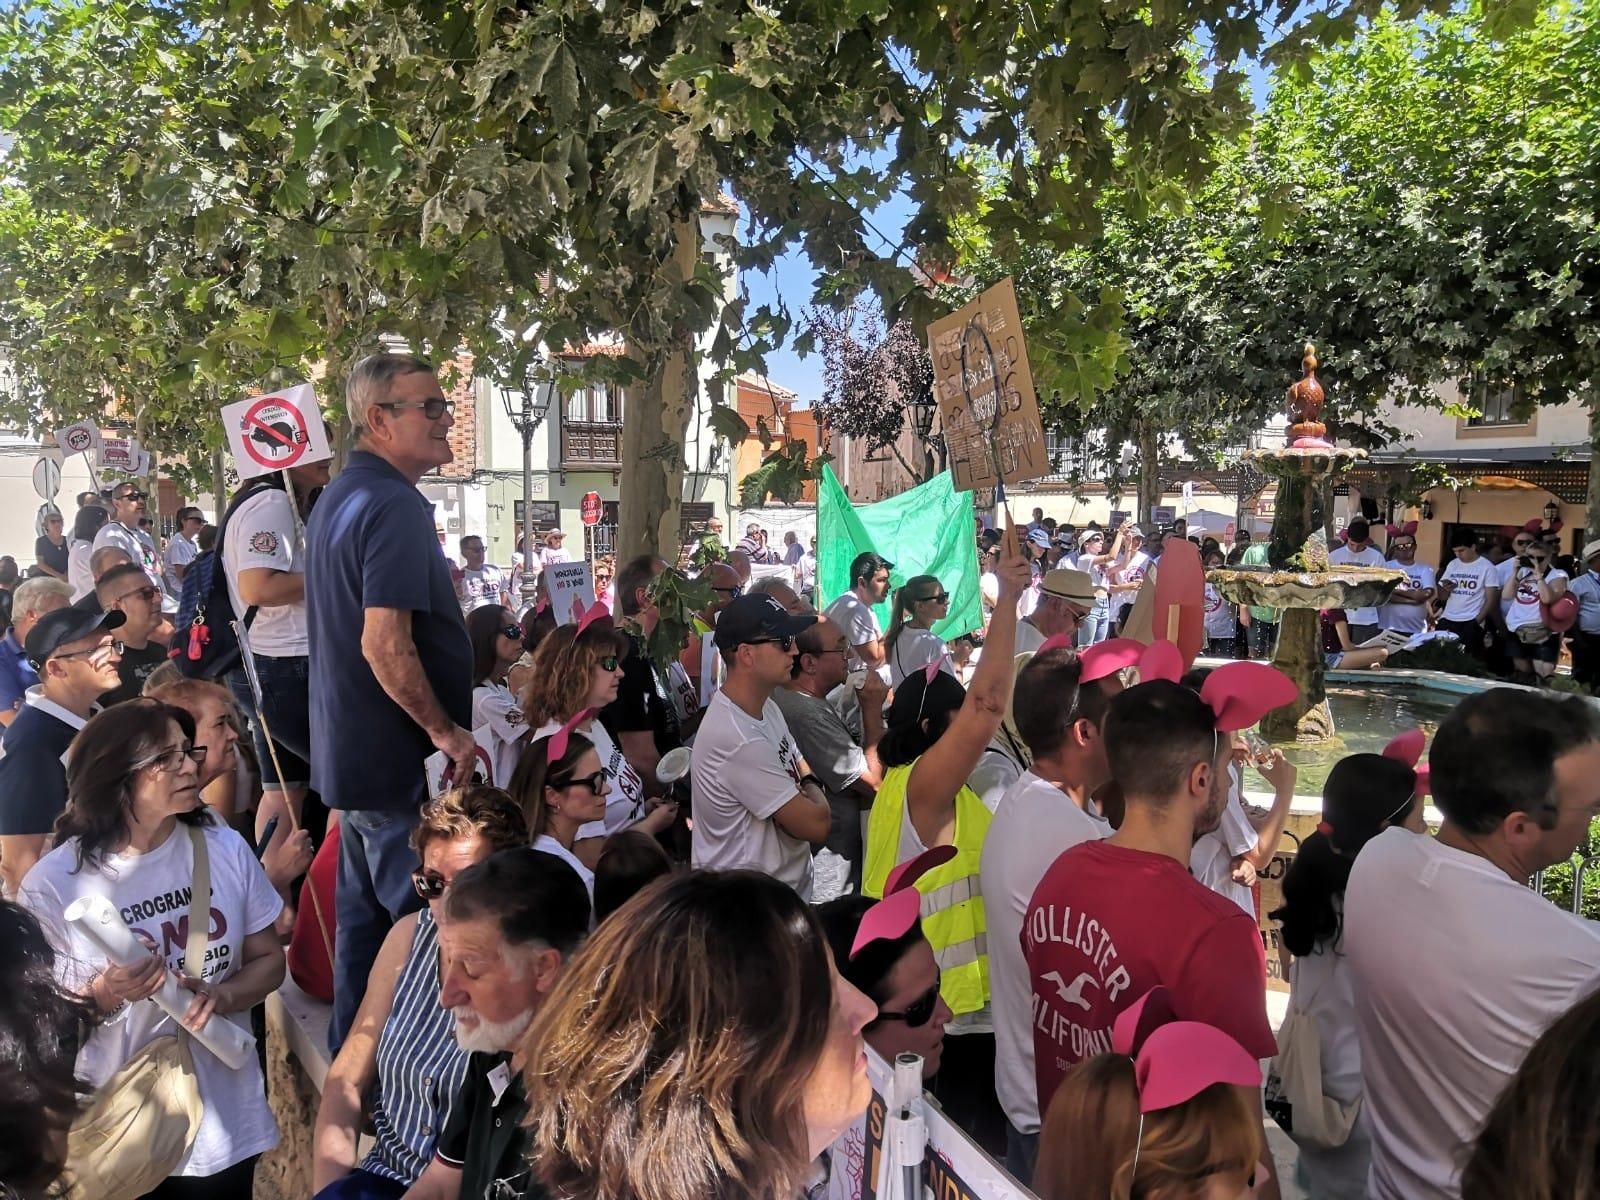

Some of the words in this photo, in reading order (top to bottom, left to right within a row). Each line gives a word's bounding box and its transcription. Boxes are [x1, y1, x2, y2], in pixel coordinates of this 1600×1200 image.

[1459, 579, 1477, 589] NO
[1027, 904, 1131, 1003] HOLLISTER
[1032, 992, 1115, 1062] ALIFORNI
